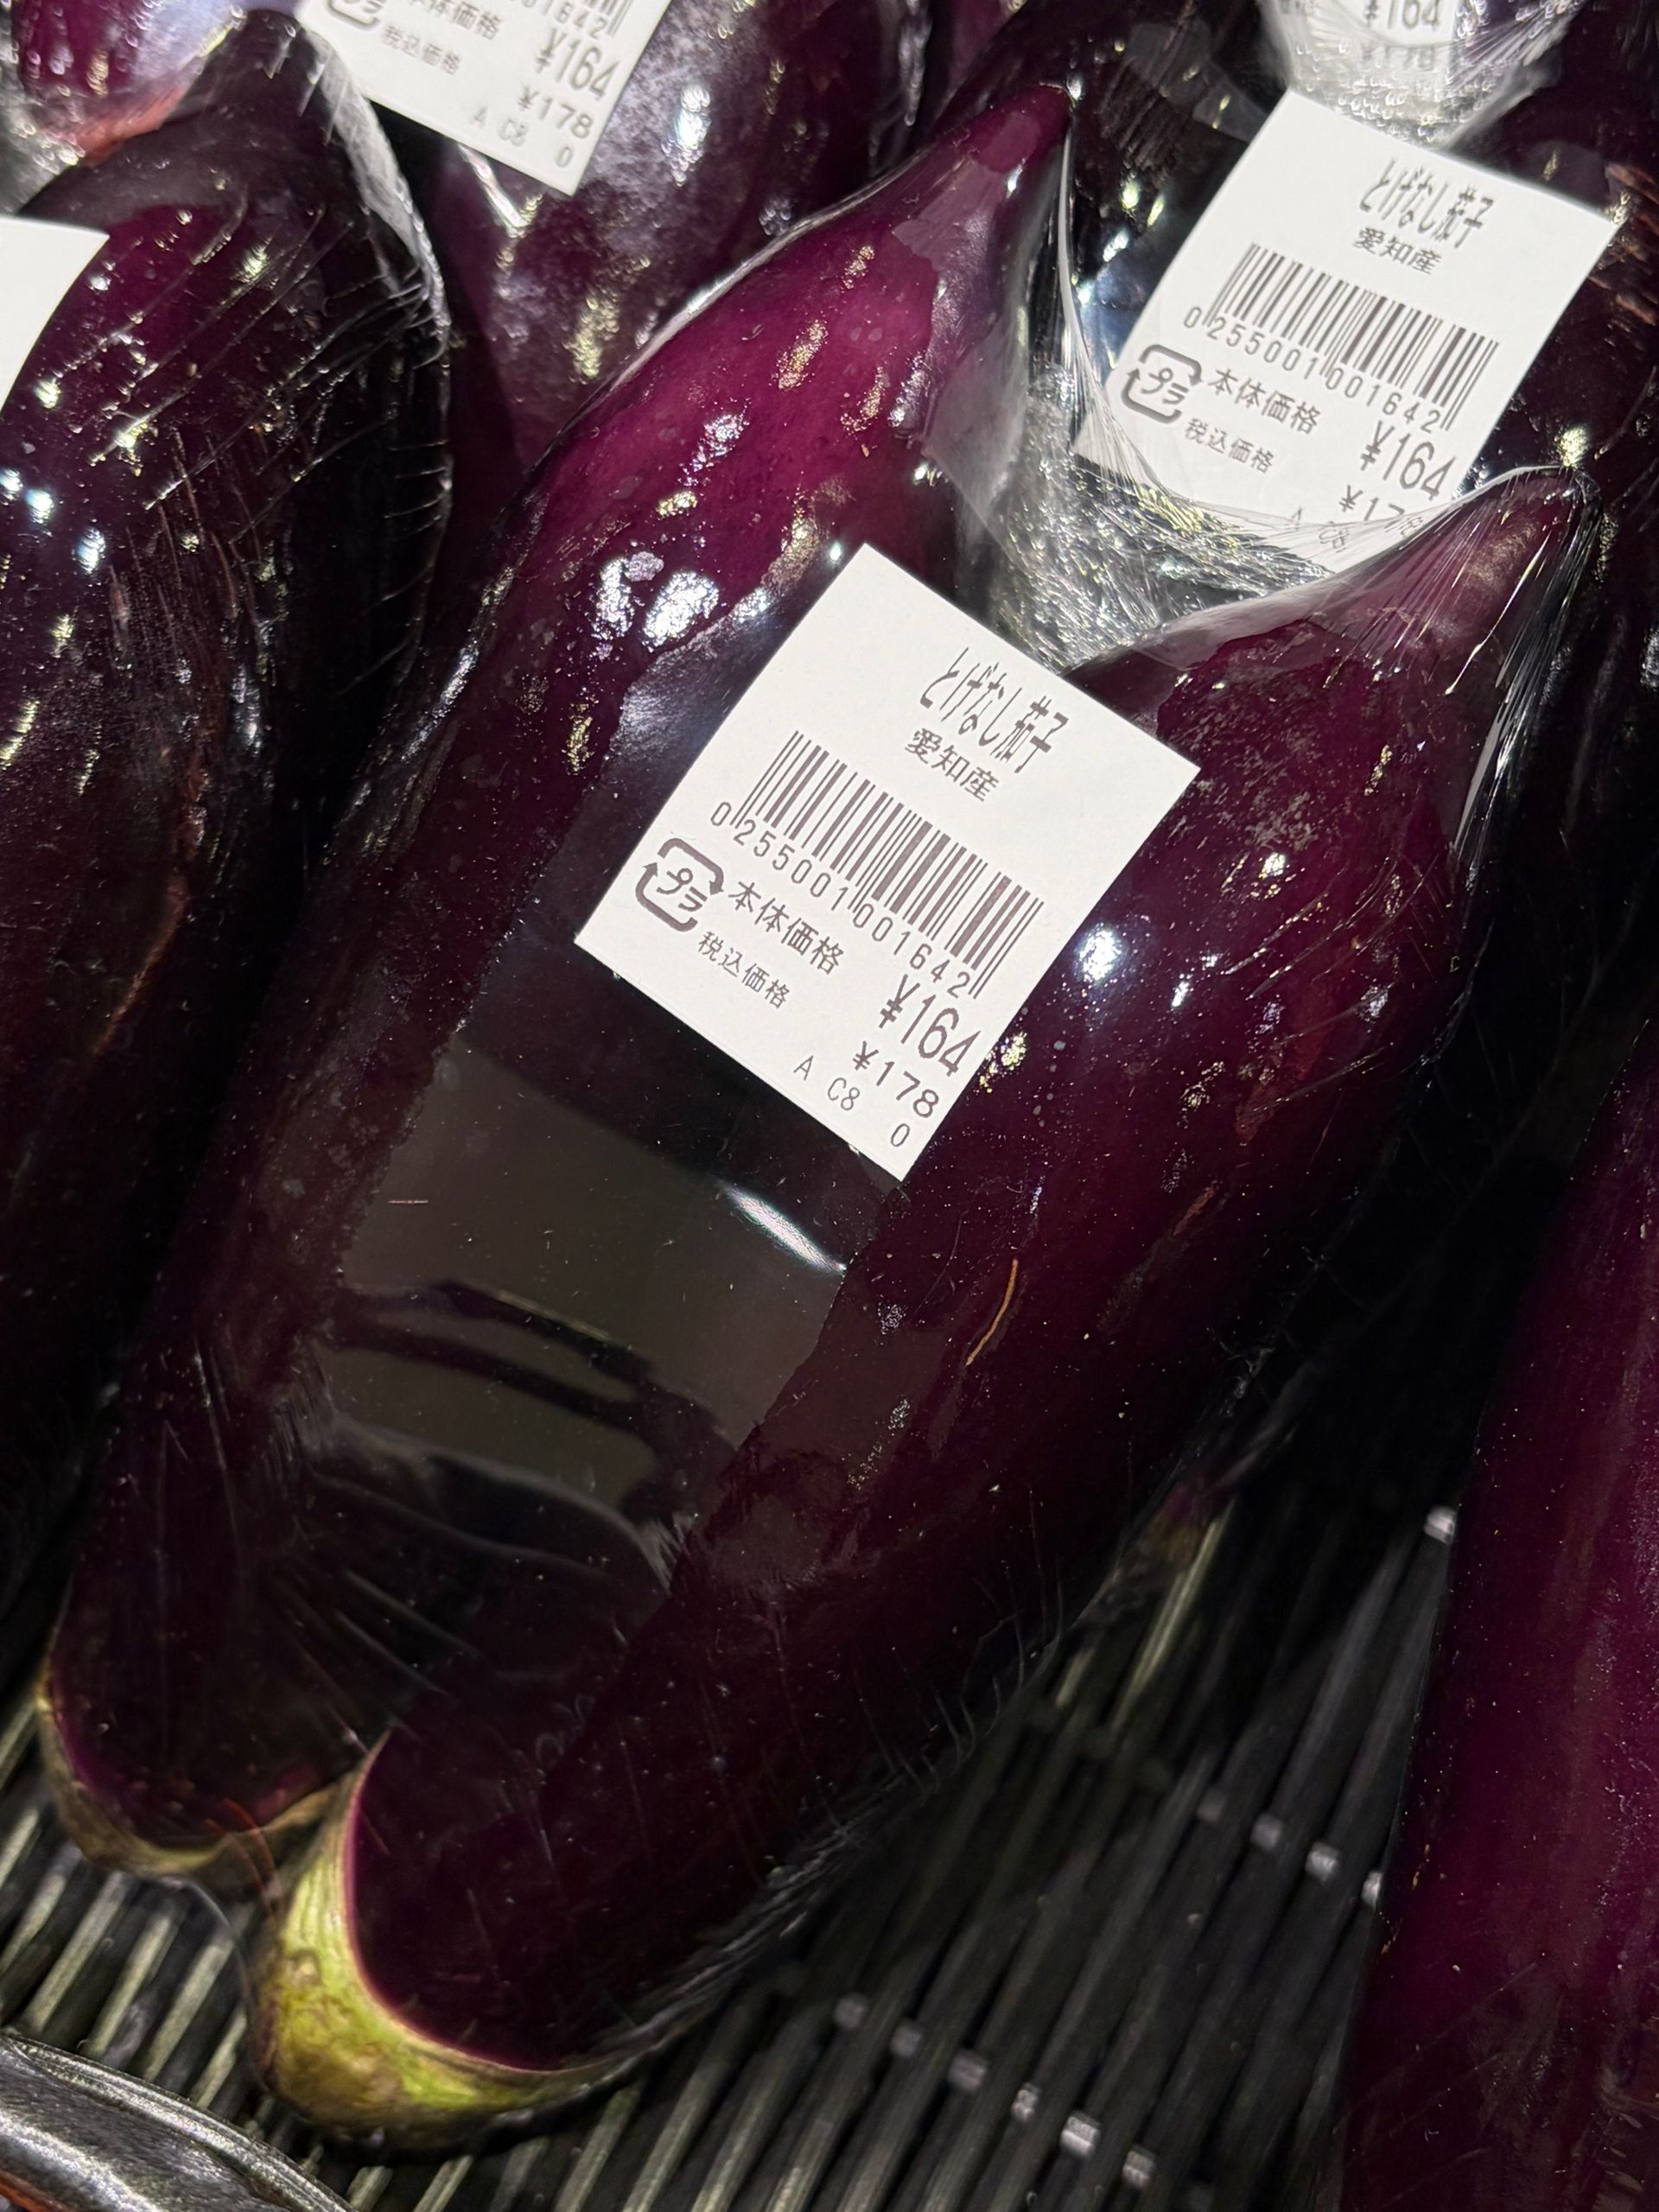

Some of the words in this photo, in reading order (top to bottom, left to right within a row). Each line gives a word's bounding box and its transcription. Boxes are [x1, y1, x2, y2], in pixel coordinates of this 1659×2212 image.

[535, 27, 621, 101] ¥164
[518, 85, 595, 140] ¥178
[1353, 227, 1442, 276] 愛知産
[1184, 416, 1276, 475] 税込価格
[1207, 366, 1322, 435] 本体価格
[1360, 420, 1457, 501] ¥164
[919, 646, 1069, 774] とげなし茄子
[905, 728, 1000, 802] 愛知産
[727, 880, 845, 976] 本体価格
[878, 973, 982, 1077] ¥164
[696, 931, 791, 1009] 税込価格
[851, 1040, 941, 1119] ¥178
[793, 1055, 812, 1082] A
[826, 1078, 862, 1112] C8
[890, 1123, 911, 1149] 0
